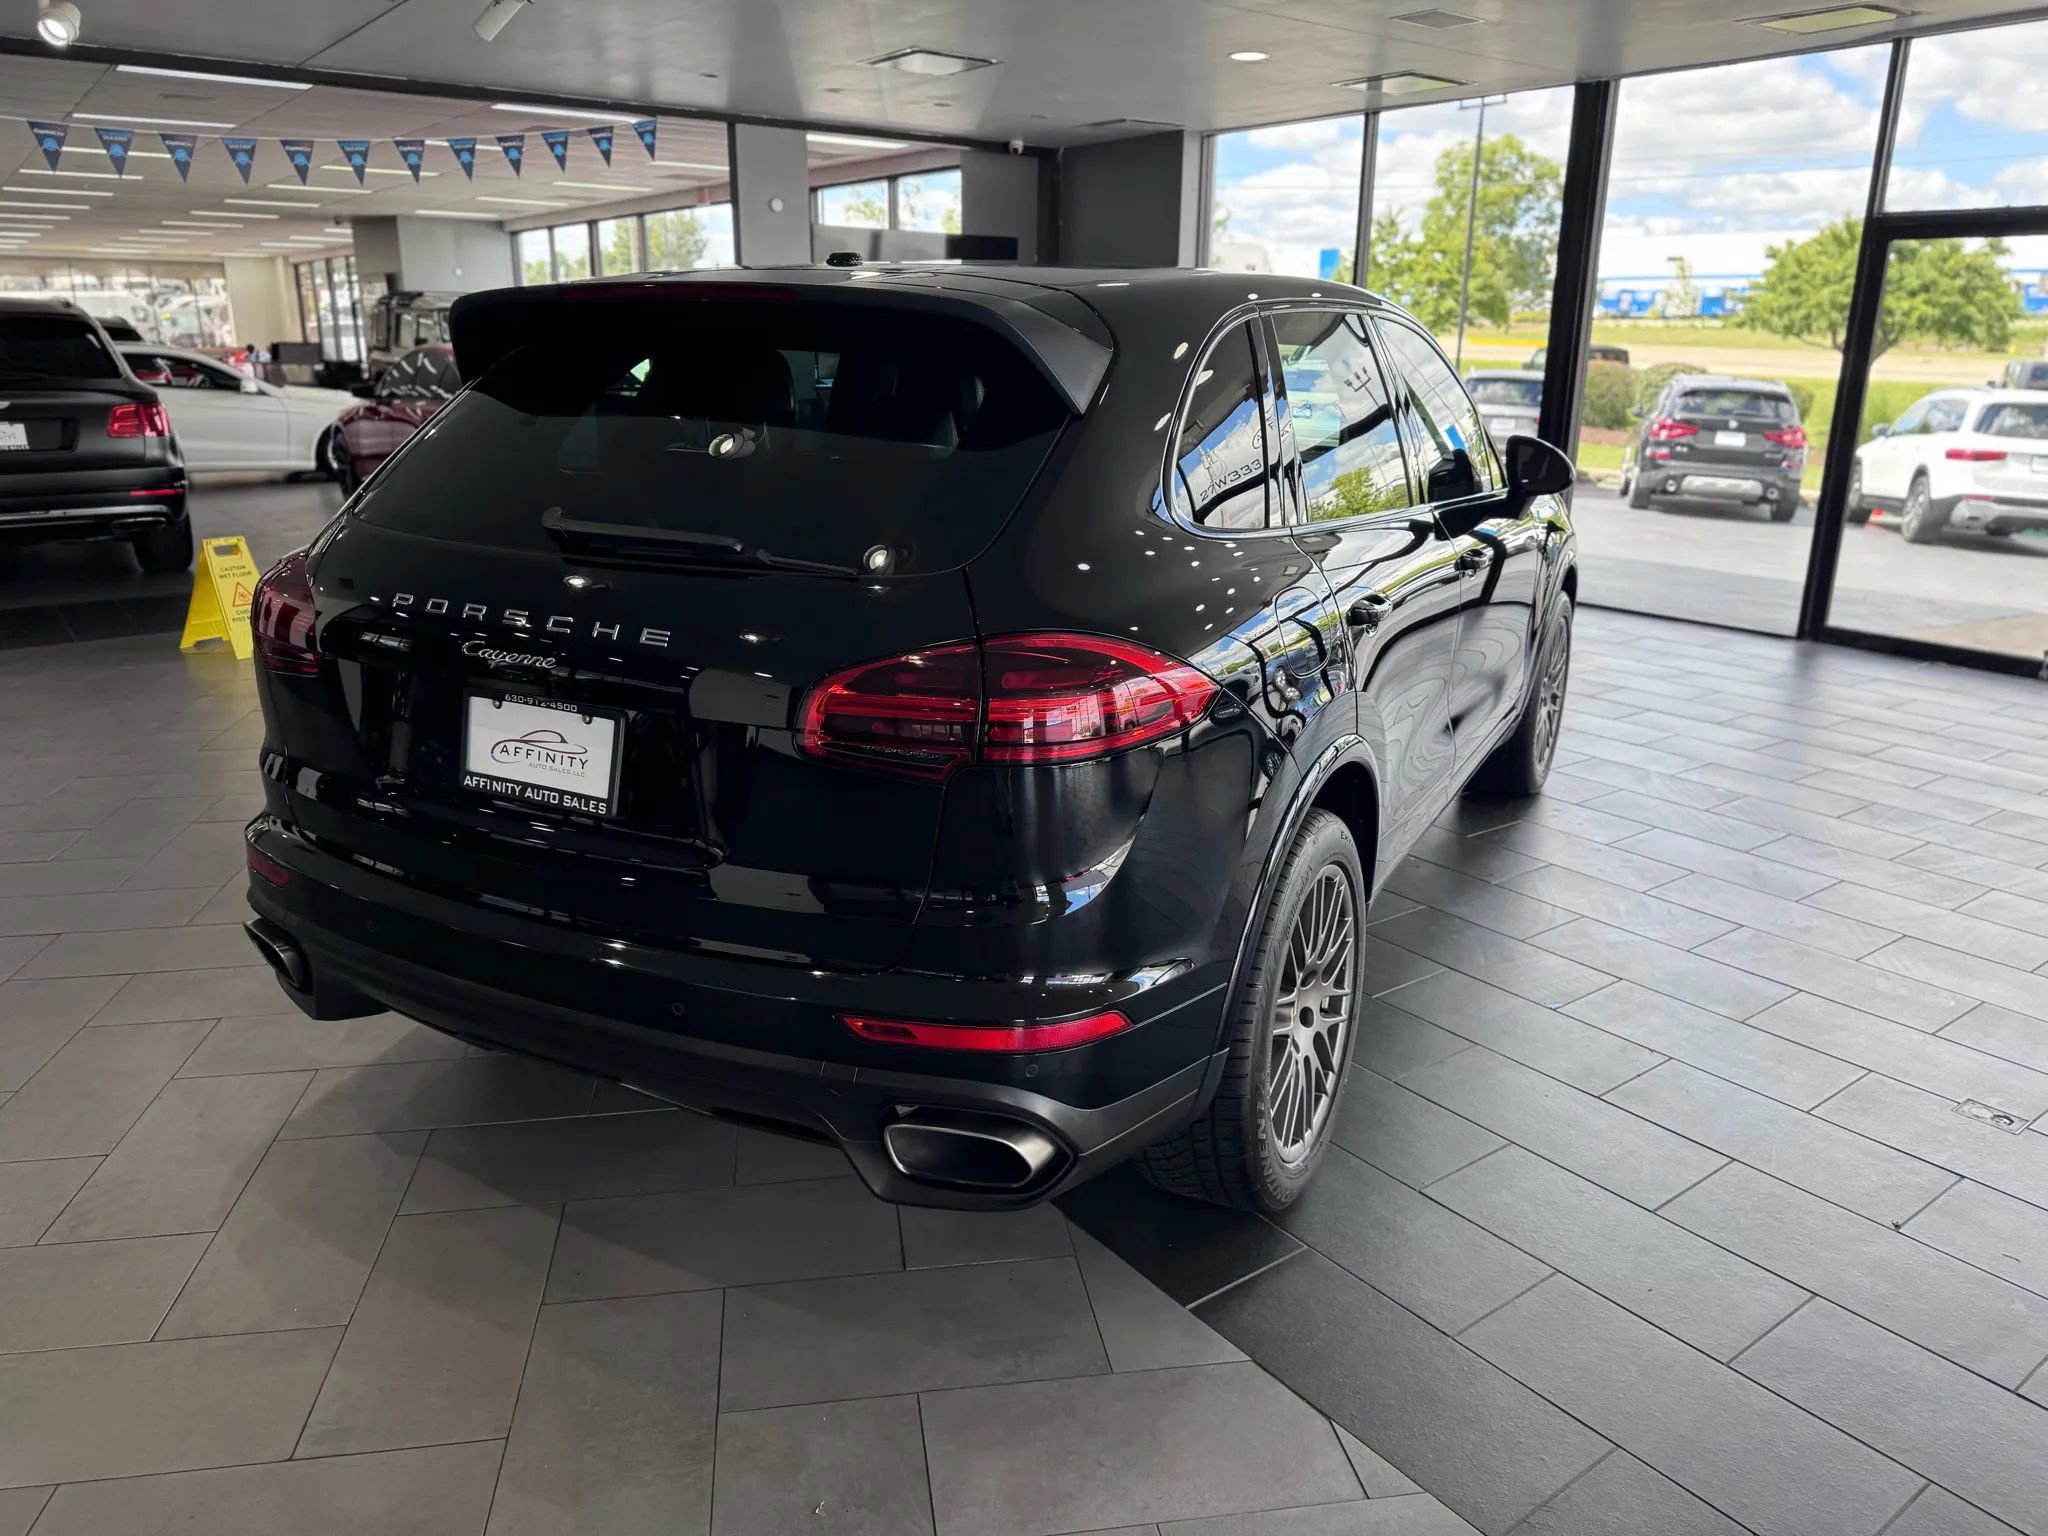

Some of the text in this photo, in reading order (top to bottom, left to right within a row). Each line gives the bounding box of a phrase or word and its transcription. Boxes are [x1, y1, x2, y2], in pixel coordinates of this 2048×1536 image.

[1200, 459, 1262, 503] 27W333
[392, 592, 671, 648] PORSCHE
[461, 640, 557, 669] Cayenne
[499, 744, 588, 770] AFFINITY
[528, 762, 585, 778] AUTO SALES LLC
[463, 775, 607, 815] AFFINITY AUTO SALES
